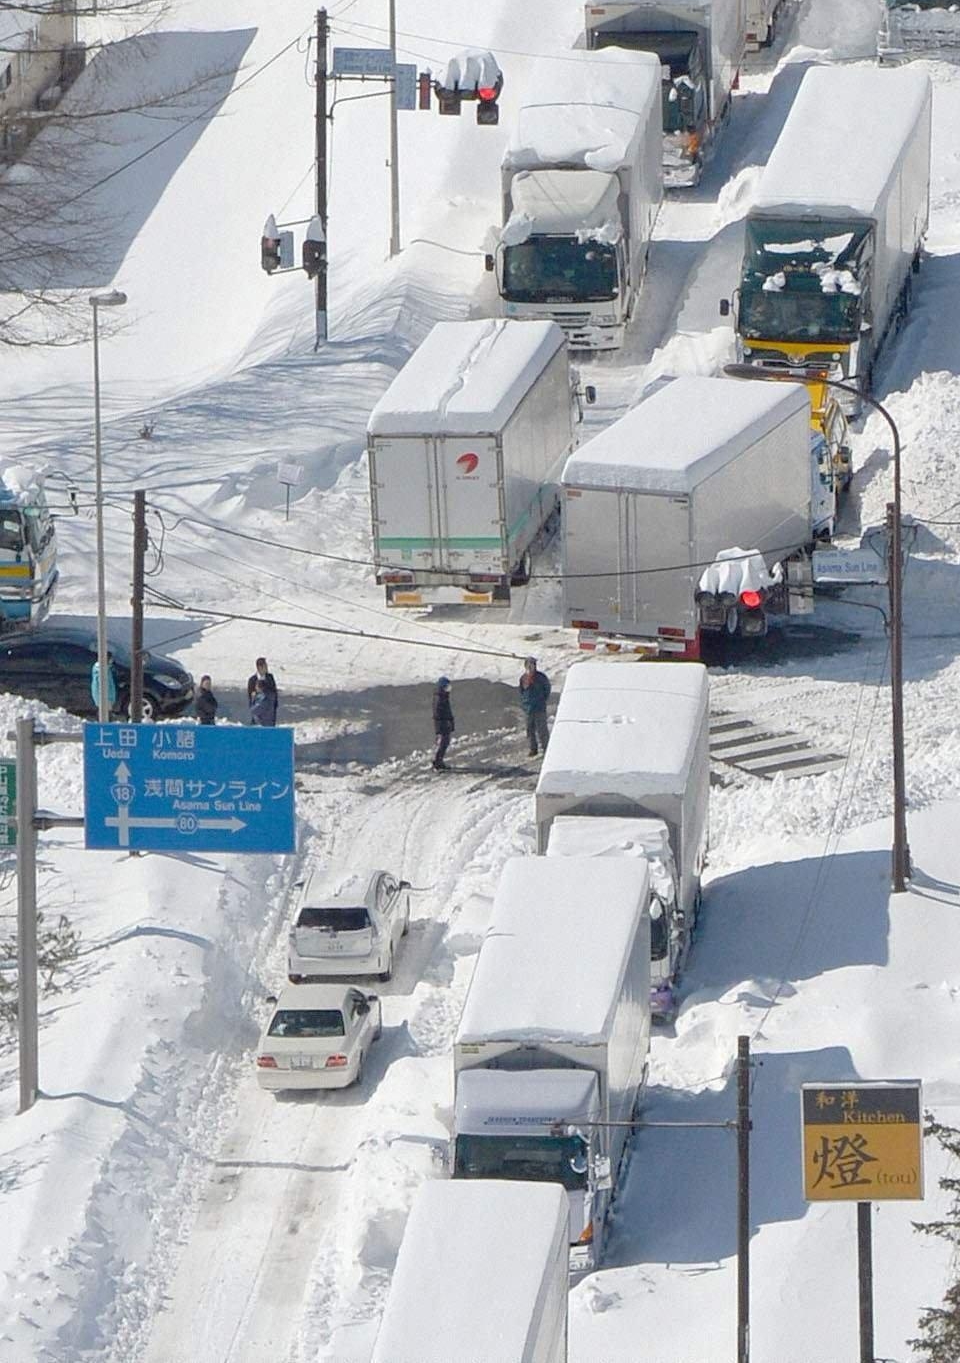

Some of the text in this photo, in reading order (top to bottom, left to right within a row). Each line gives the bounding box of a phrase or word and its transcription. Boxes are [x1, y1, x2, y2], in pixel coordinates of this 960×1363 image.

[845, 562, 860, 572] Sun
[95, 728, 195, 747] 上田 小諸
[102, 748, 195, 760] Ueda Komoro
[115, 787, 130, 800] 18
[143, 779, 289, 799] 浅間サンライン
[172, 800, 262, 812] Asama Sun Line
[179, 818, 195, 829] 80
[815, 1090, 859, 1109] 和洋
[843, 1109, 906, 1124] Kitchen
[812, 1133, 878, 1189] 燈
[876, 1167, 918, 1185] (tou)
